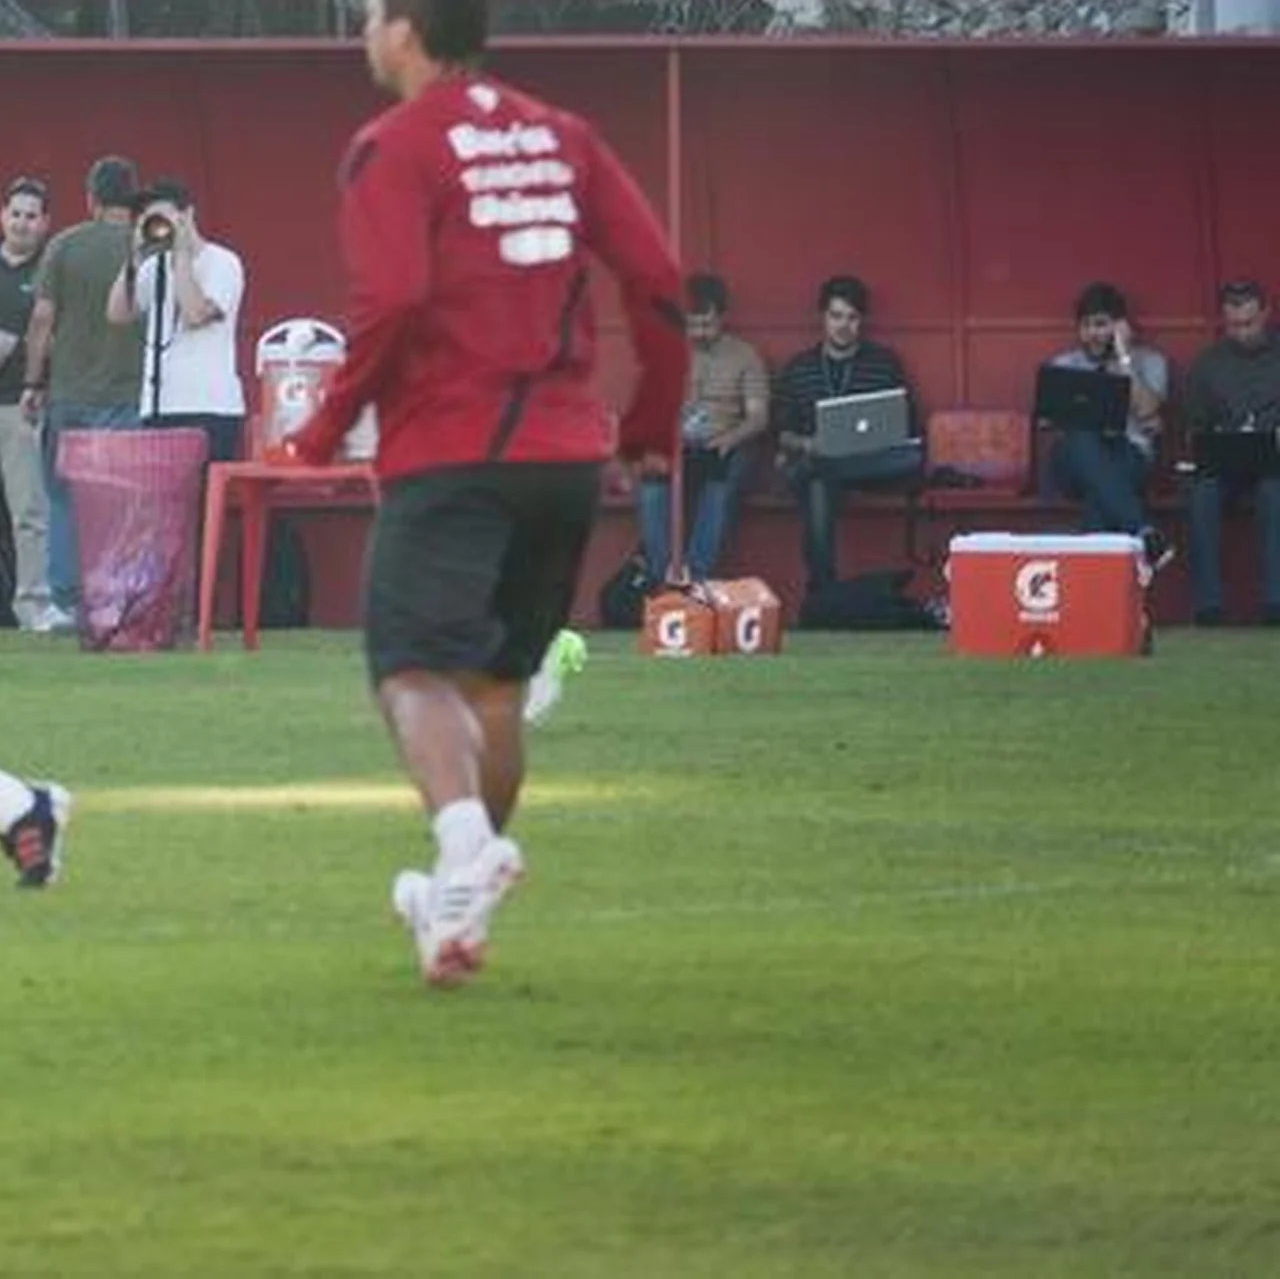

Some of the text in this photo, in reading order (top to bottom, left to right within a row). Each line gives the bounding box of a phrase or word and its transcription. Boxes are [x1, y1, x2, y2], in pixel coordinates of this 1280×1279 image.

[1016, 560, 1058, 609] G
[658, 609, 686, 647] G
[736, 605, 761, 653] G
